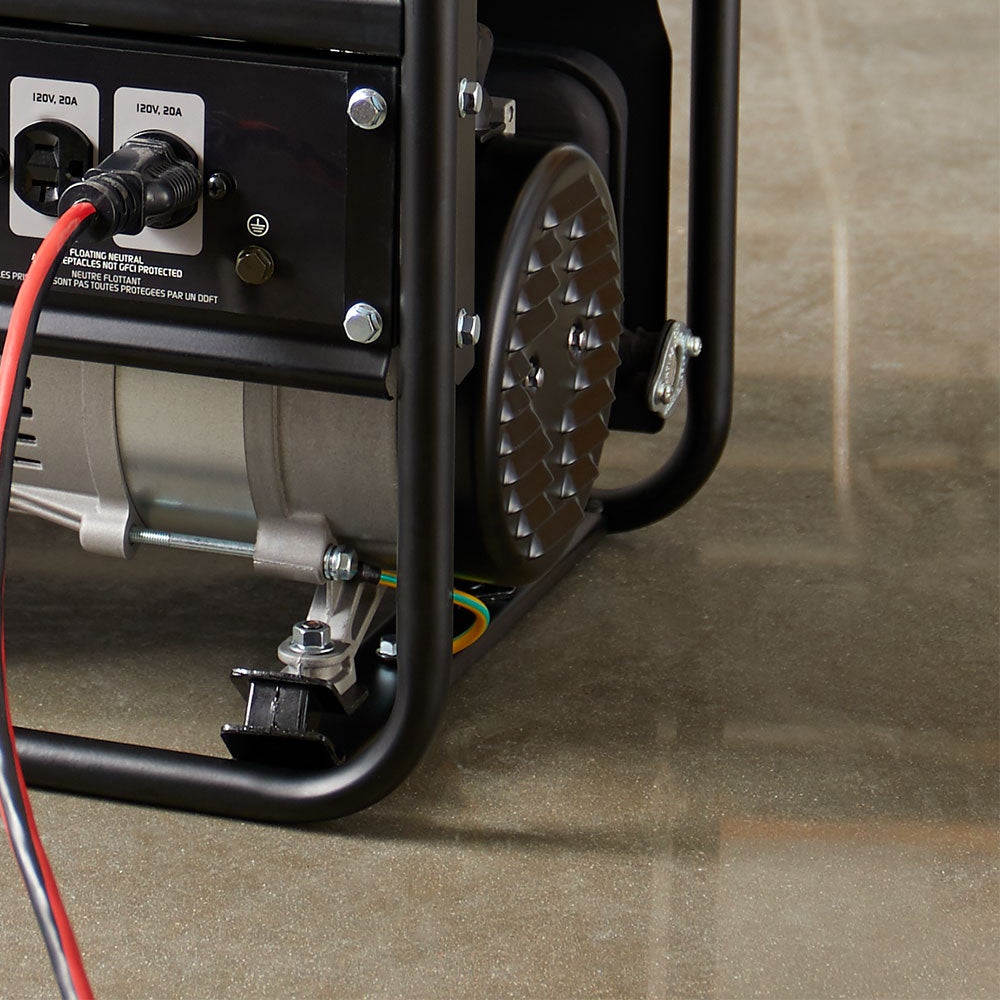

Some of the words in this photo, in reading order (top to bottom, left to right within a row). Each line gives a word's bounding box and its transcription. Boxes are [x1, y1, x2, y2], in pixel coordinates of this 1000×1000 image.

[32, 92, 57, 104] 120V,
[59, 95, 78, 106] 20A
[136, 103, 161, 115] 120V,
[163, 106, 182, 117] 20A
[69, 248, 107, 260] FLOATING
[108, 252, 144, 265] NEUTRAL
[62, 256, 101, 269] EPTACLES
[102, 261, 117, 270] NOT
[119, 262, 136, 272] GFCI
[138, 265, 183, 278] PROTECTED
[71, 270, 102, 281] NEUTRE
[103, 273, 141, 286] FLOTTANT
[52, 276, 72, 287] SONT
[73, 279, 89, 289] PAS
[91, 281, 119, 292] TOUTES
[167, 289, 184, 300] PAR
[184, 292, 196, 302] UN
[197, 294, 218, 304] DDFT
